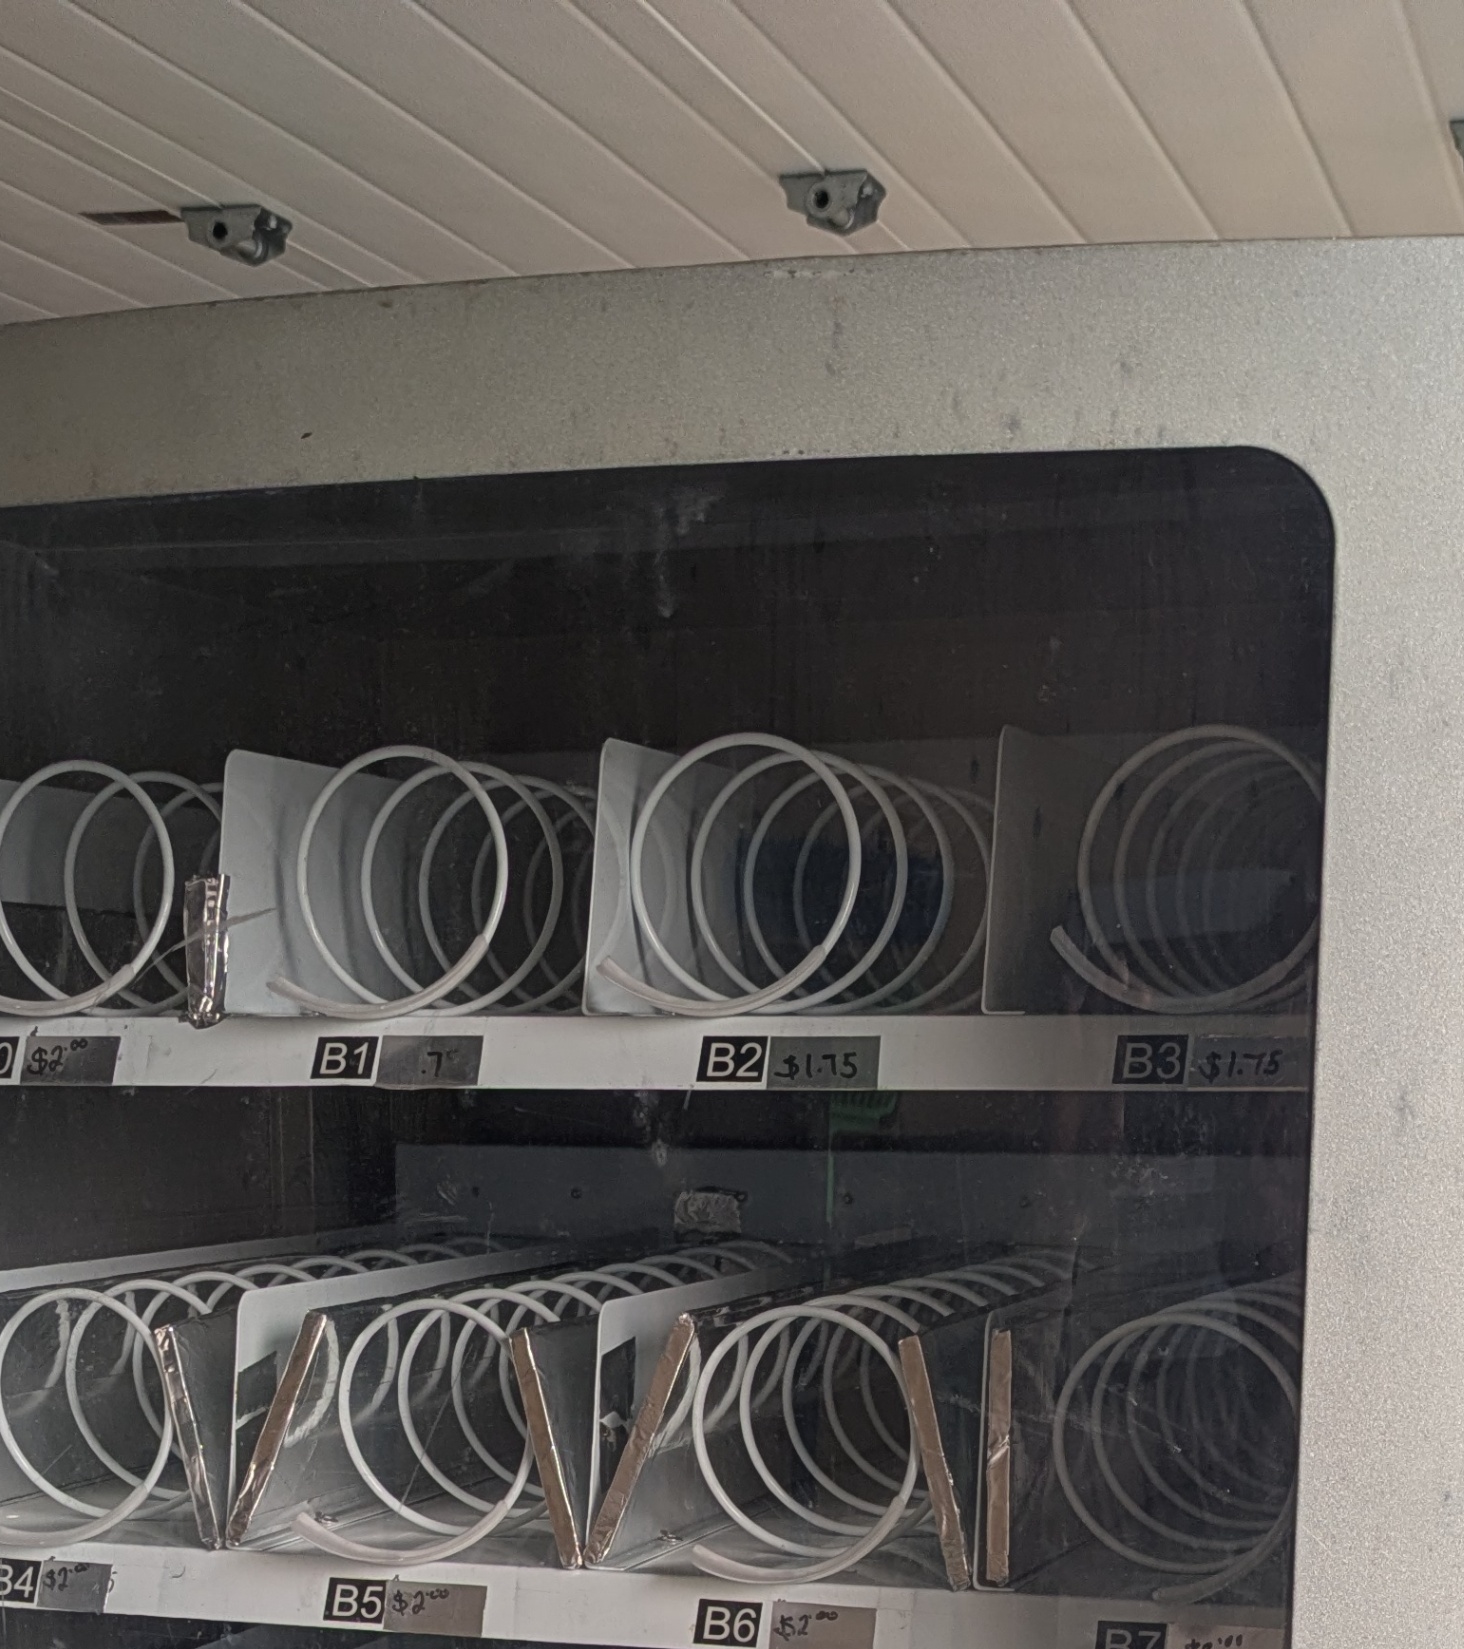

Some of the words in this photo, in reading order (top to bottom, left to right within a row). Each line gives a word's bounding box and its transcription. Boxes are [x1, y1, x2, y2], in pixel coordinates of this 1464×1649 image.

[319, 1041, 370, 1075] B1
[706, 1041, 763, 1077] B2
[774, 1051, 858, 1081] $1.75
[1122, 1041, 1182, 1079] B3
[1198, 1050, 1283, 1084] $1.75
[332, 1584, 384, 1619] B5
[702, 1605, 757, 1643] B6
